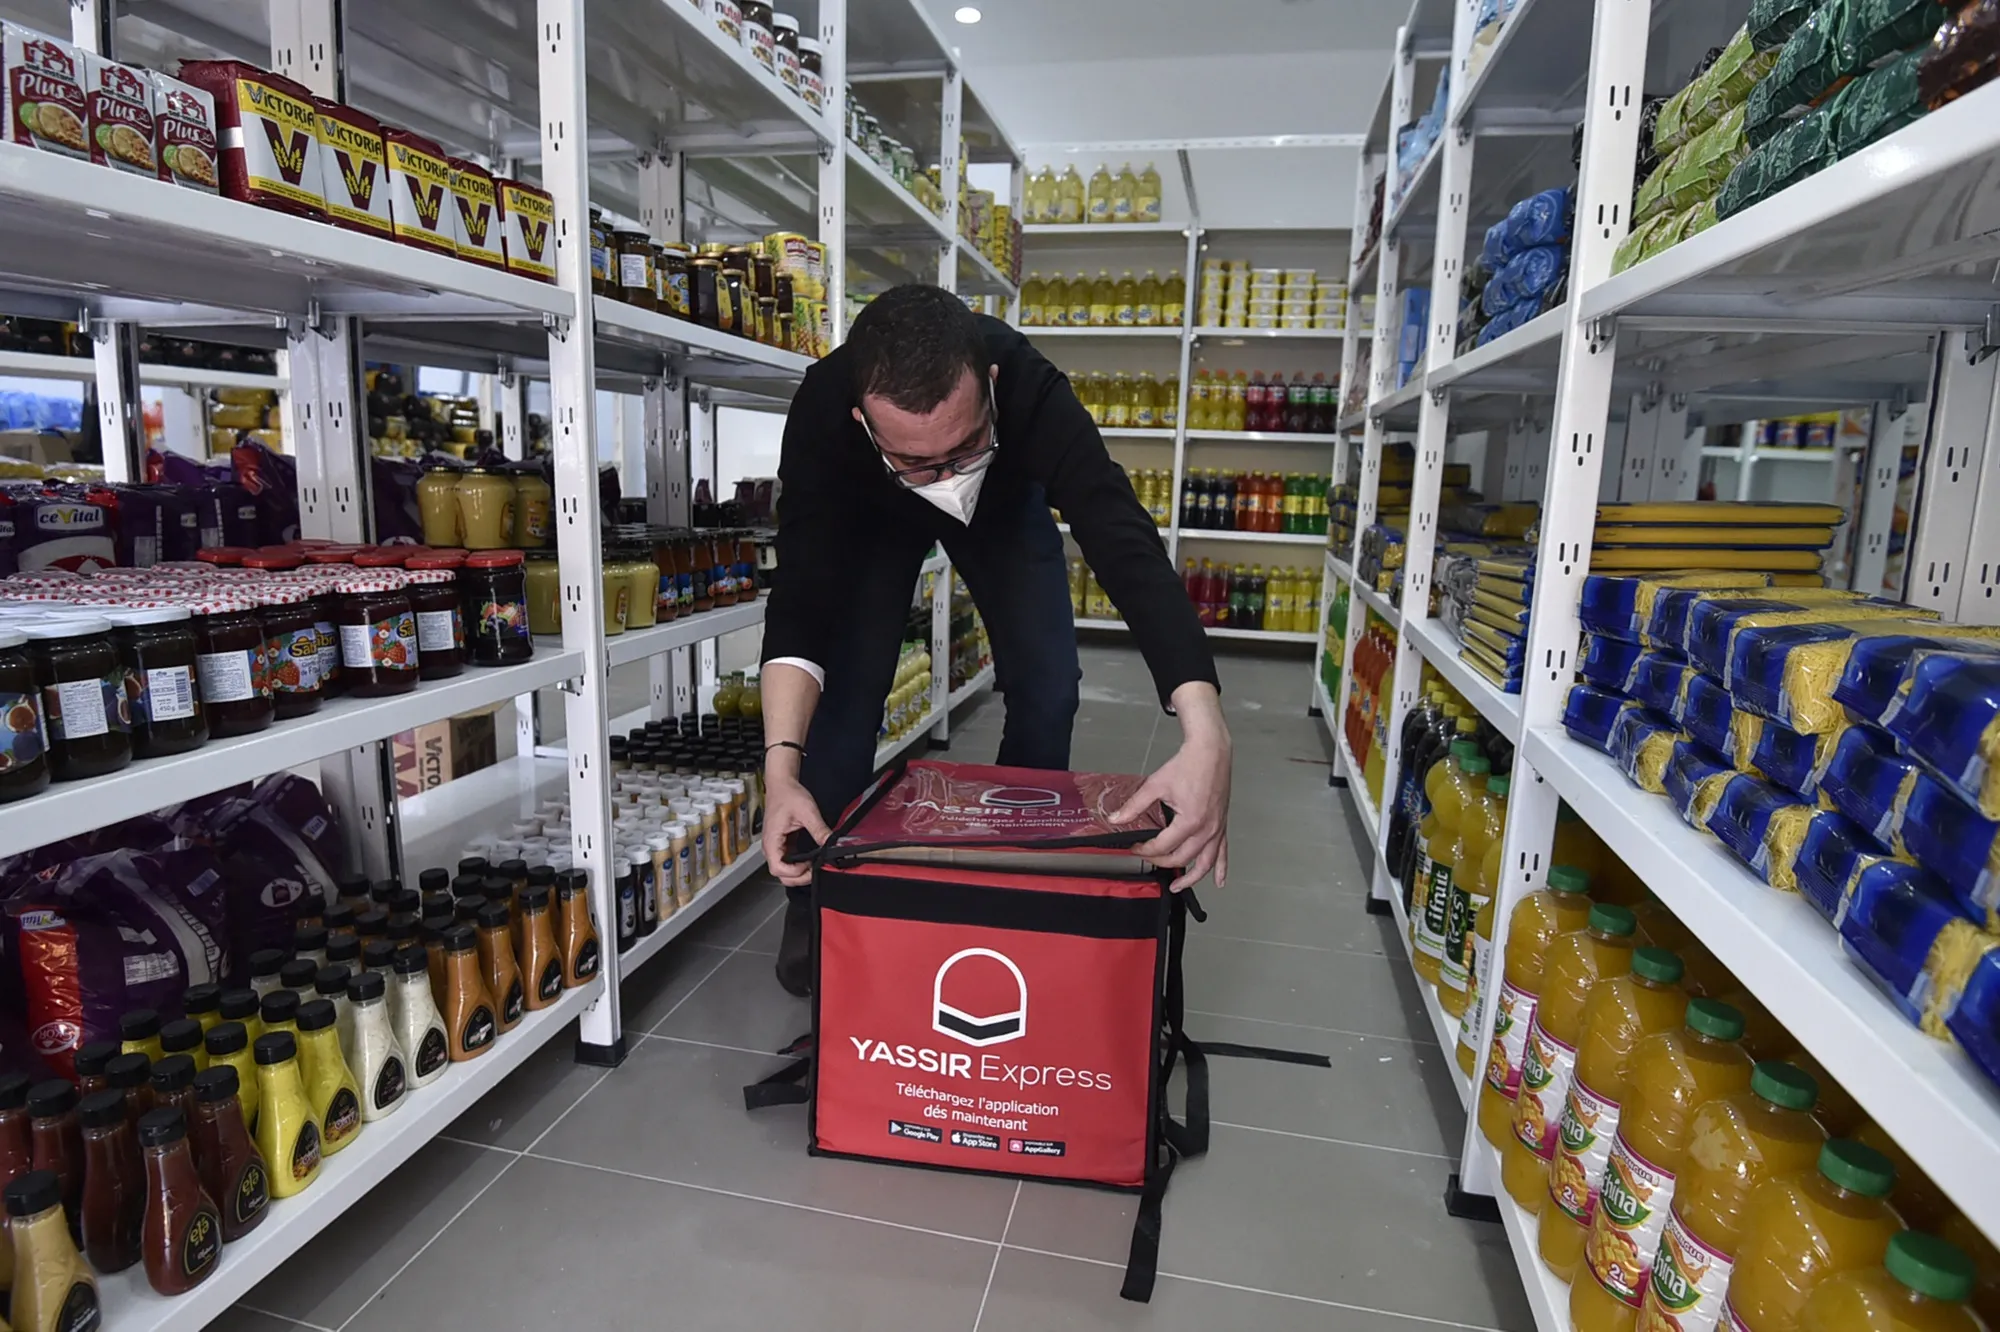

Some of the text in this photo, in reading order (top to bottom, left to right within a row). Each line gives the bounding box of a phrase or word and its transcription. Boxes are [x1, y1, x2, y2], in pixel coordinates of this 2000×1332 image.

[20, 73, 66, 99] Plus
[96, 97, 137, 122] Plus
[163, 119, 201, 142] Plus
[40, 507, 99, 525] ceVital
[850, 1036, 1113, 1091] YASSIR Express
[896, 1082, 1060, 1116] Téléchargez l'application
[923, 1104, 1029, 1132] dés maintenant
[903, 1128, 940, 1142] Google Play
[1524, 1121, 1536, 1139] 2L
[962, 1138, 998, 1149] App Store
[1024, 1145, 1061, 1155] AppGallery
[1563, 1185, 1578, 1206] 2L
[1608, 1262, 1628, 1286] 2L
